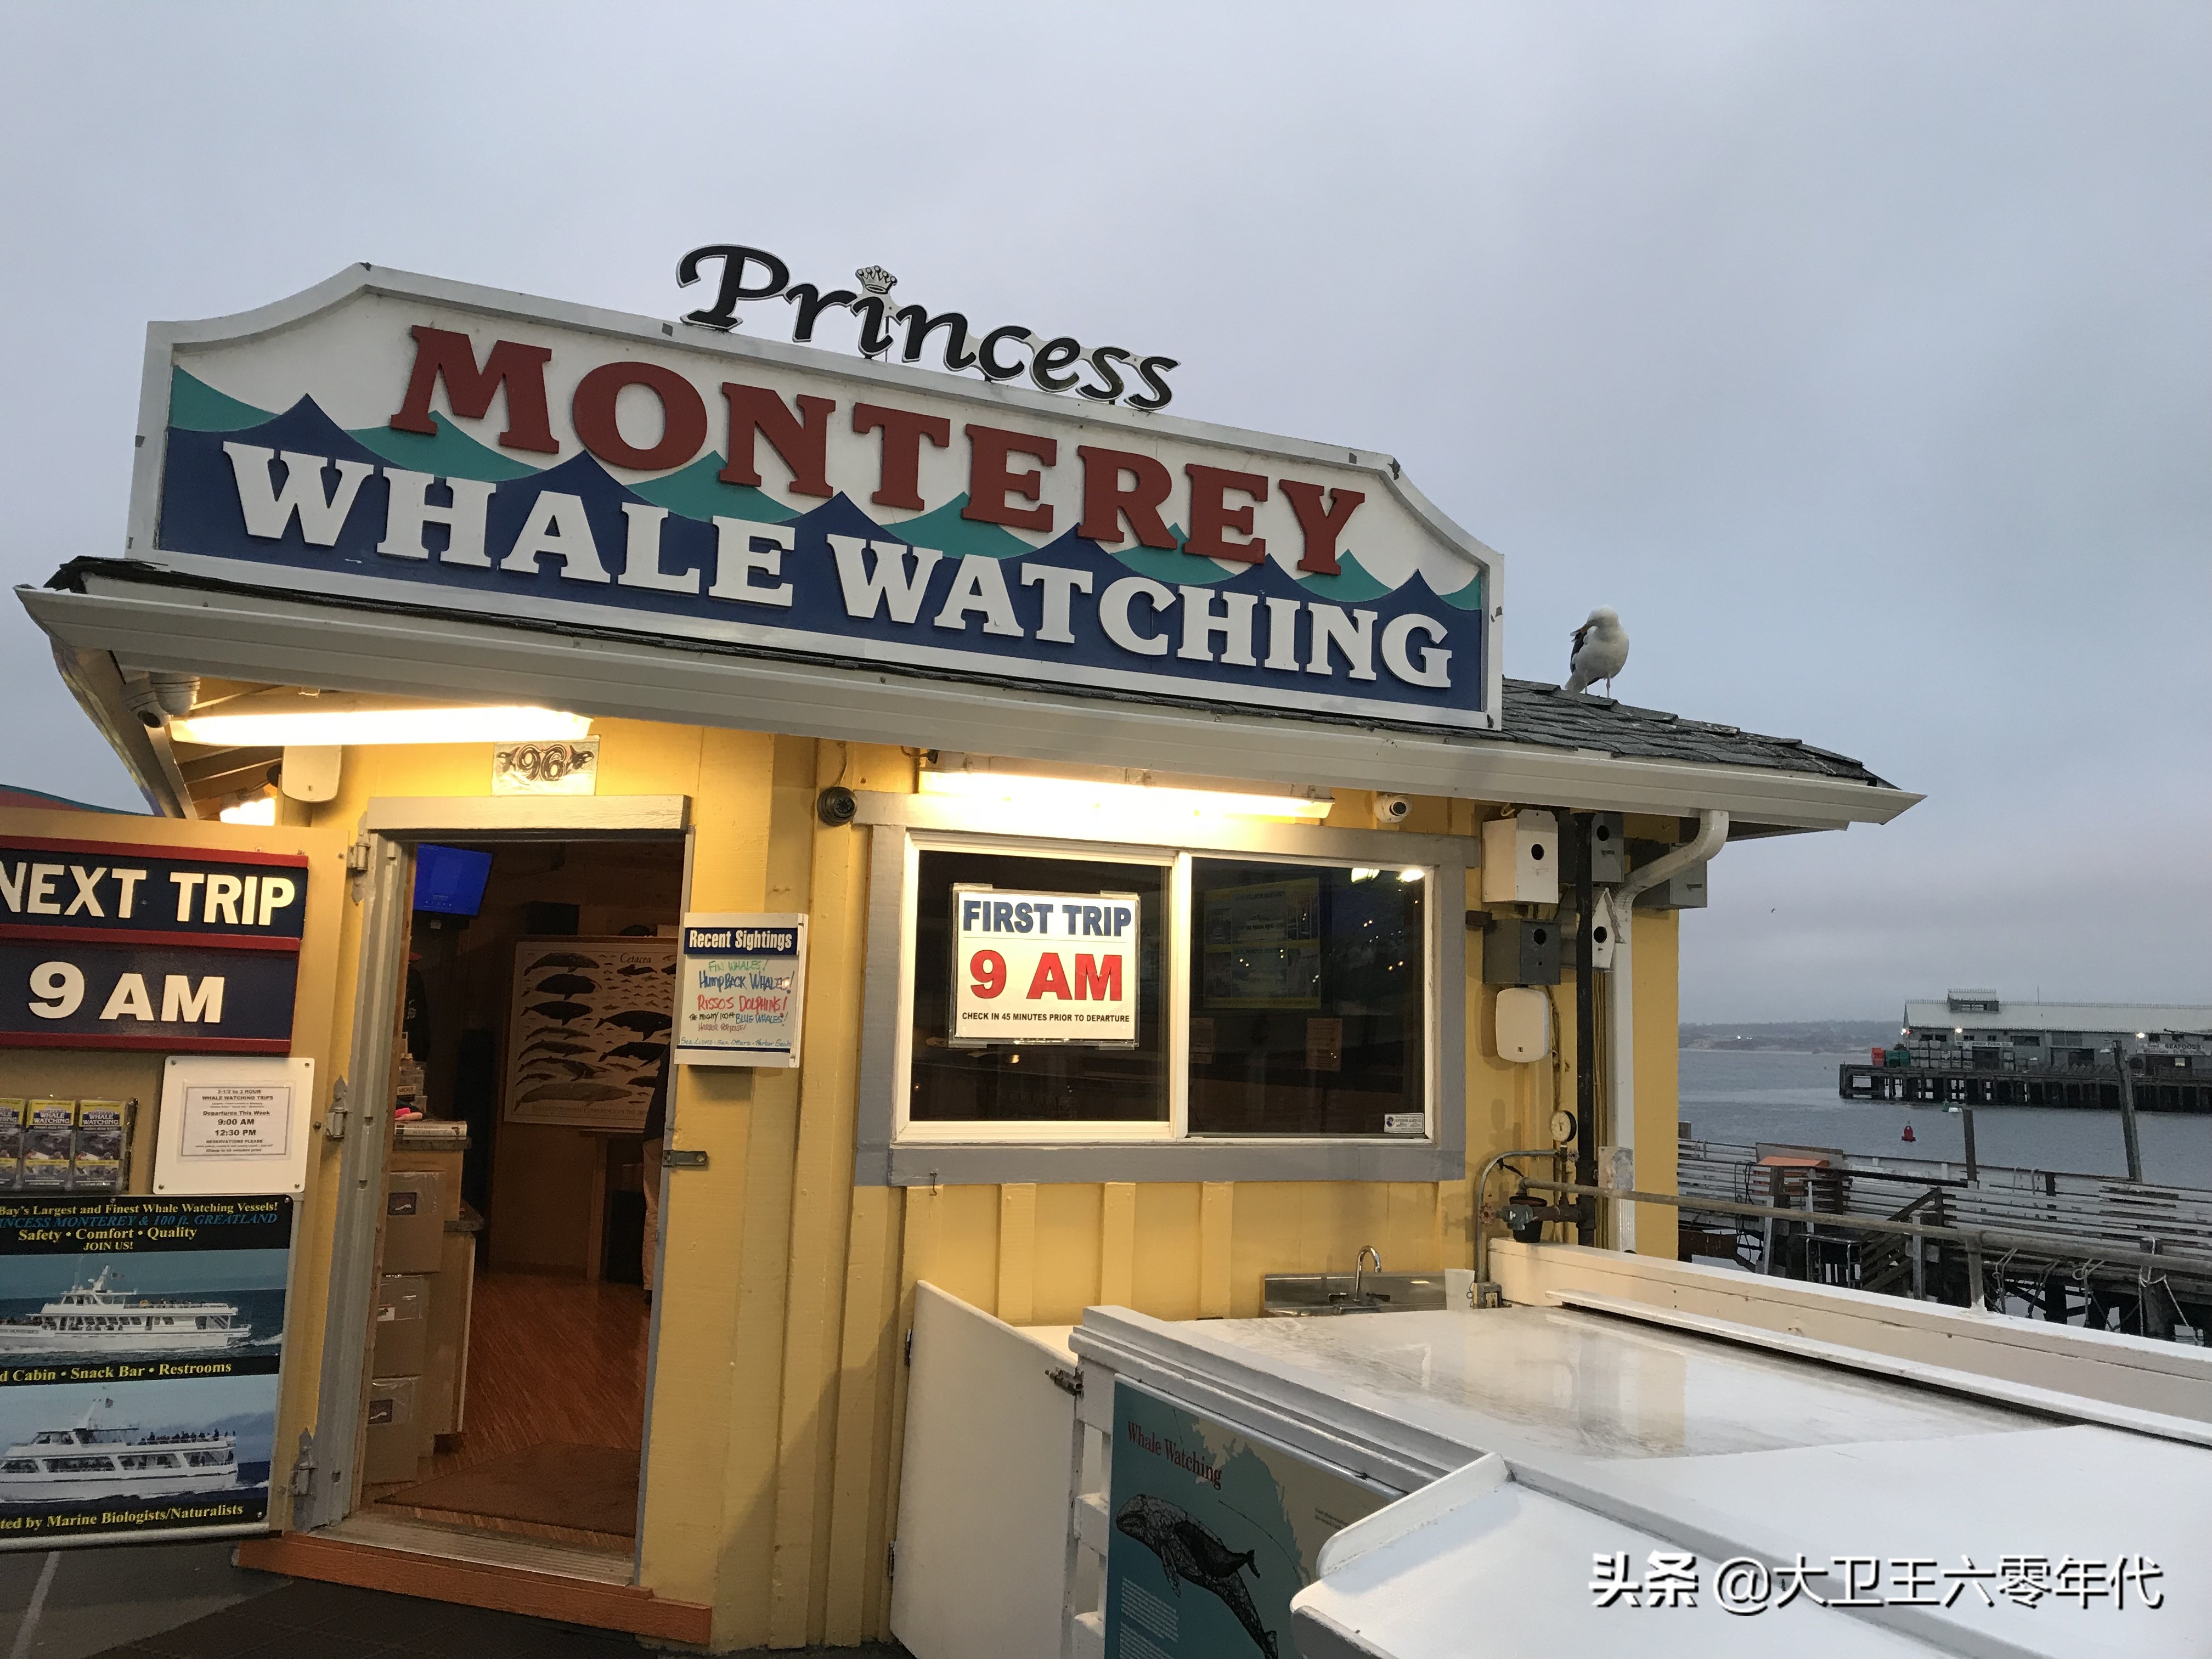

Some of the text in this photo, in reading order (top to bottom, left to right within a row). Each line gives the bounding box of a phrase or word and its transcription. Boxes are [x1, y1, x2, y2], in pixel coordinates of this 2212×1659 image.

[676, 244, 1181, 411] Princess
[390, 324, 1365, 576] MONTEREY
[223, 441, 1453, 689] WHALE WATCHING
[517, 744, 567, 782] 96
[0, 862, 295, 926] NEXT TRIP
[963, 900, 1131, 936] FIRST TRIP
[620, 953, 651, 963] Cetacea
[689, 930, 792, 951] Recent Sightings
[29, 961, 225, 1023] 9 AM
[970, 950, 1122, 1001] 9 AM
[0, 1201, 278, 1217] Bay's Largest and Finest Whale Watching Vessels!
[54, 1215, 137, 1227] MONTEREY
[138, 1215, 149, 1226] &
[154, 1215, 176, 1226] 100
[194, 1213, 278, 1225] GREATLAND
[18, 1227, 198, 1243] Safety Comfort Quality
[83, 1242, 134, 1251] JOIN US!
[13, 1369, 57, 1381] Cabin
[70, 1366, 114, 1380] Snack
[118, 1364, 145, 1378] Bar
[159, 1363, 232, 1375] Restrooms
[1128, 1420, 1222, 1491] Whale Watching
[25, 1516, 43, 1531] by
[47, 1514, 98, 1527] Marine
[101, 1504, 244, 1525] Biologists/Naturalists
